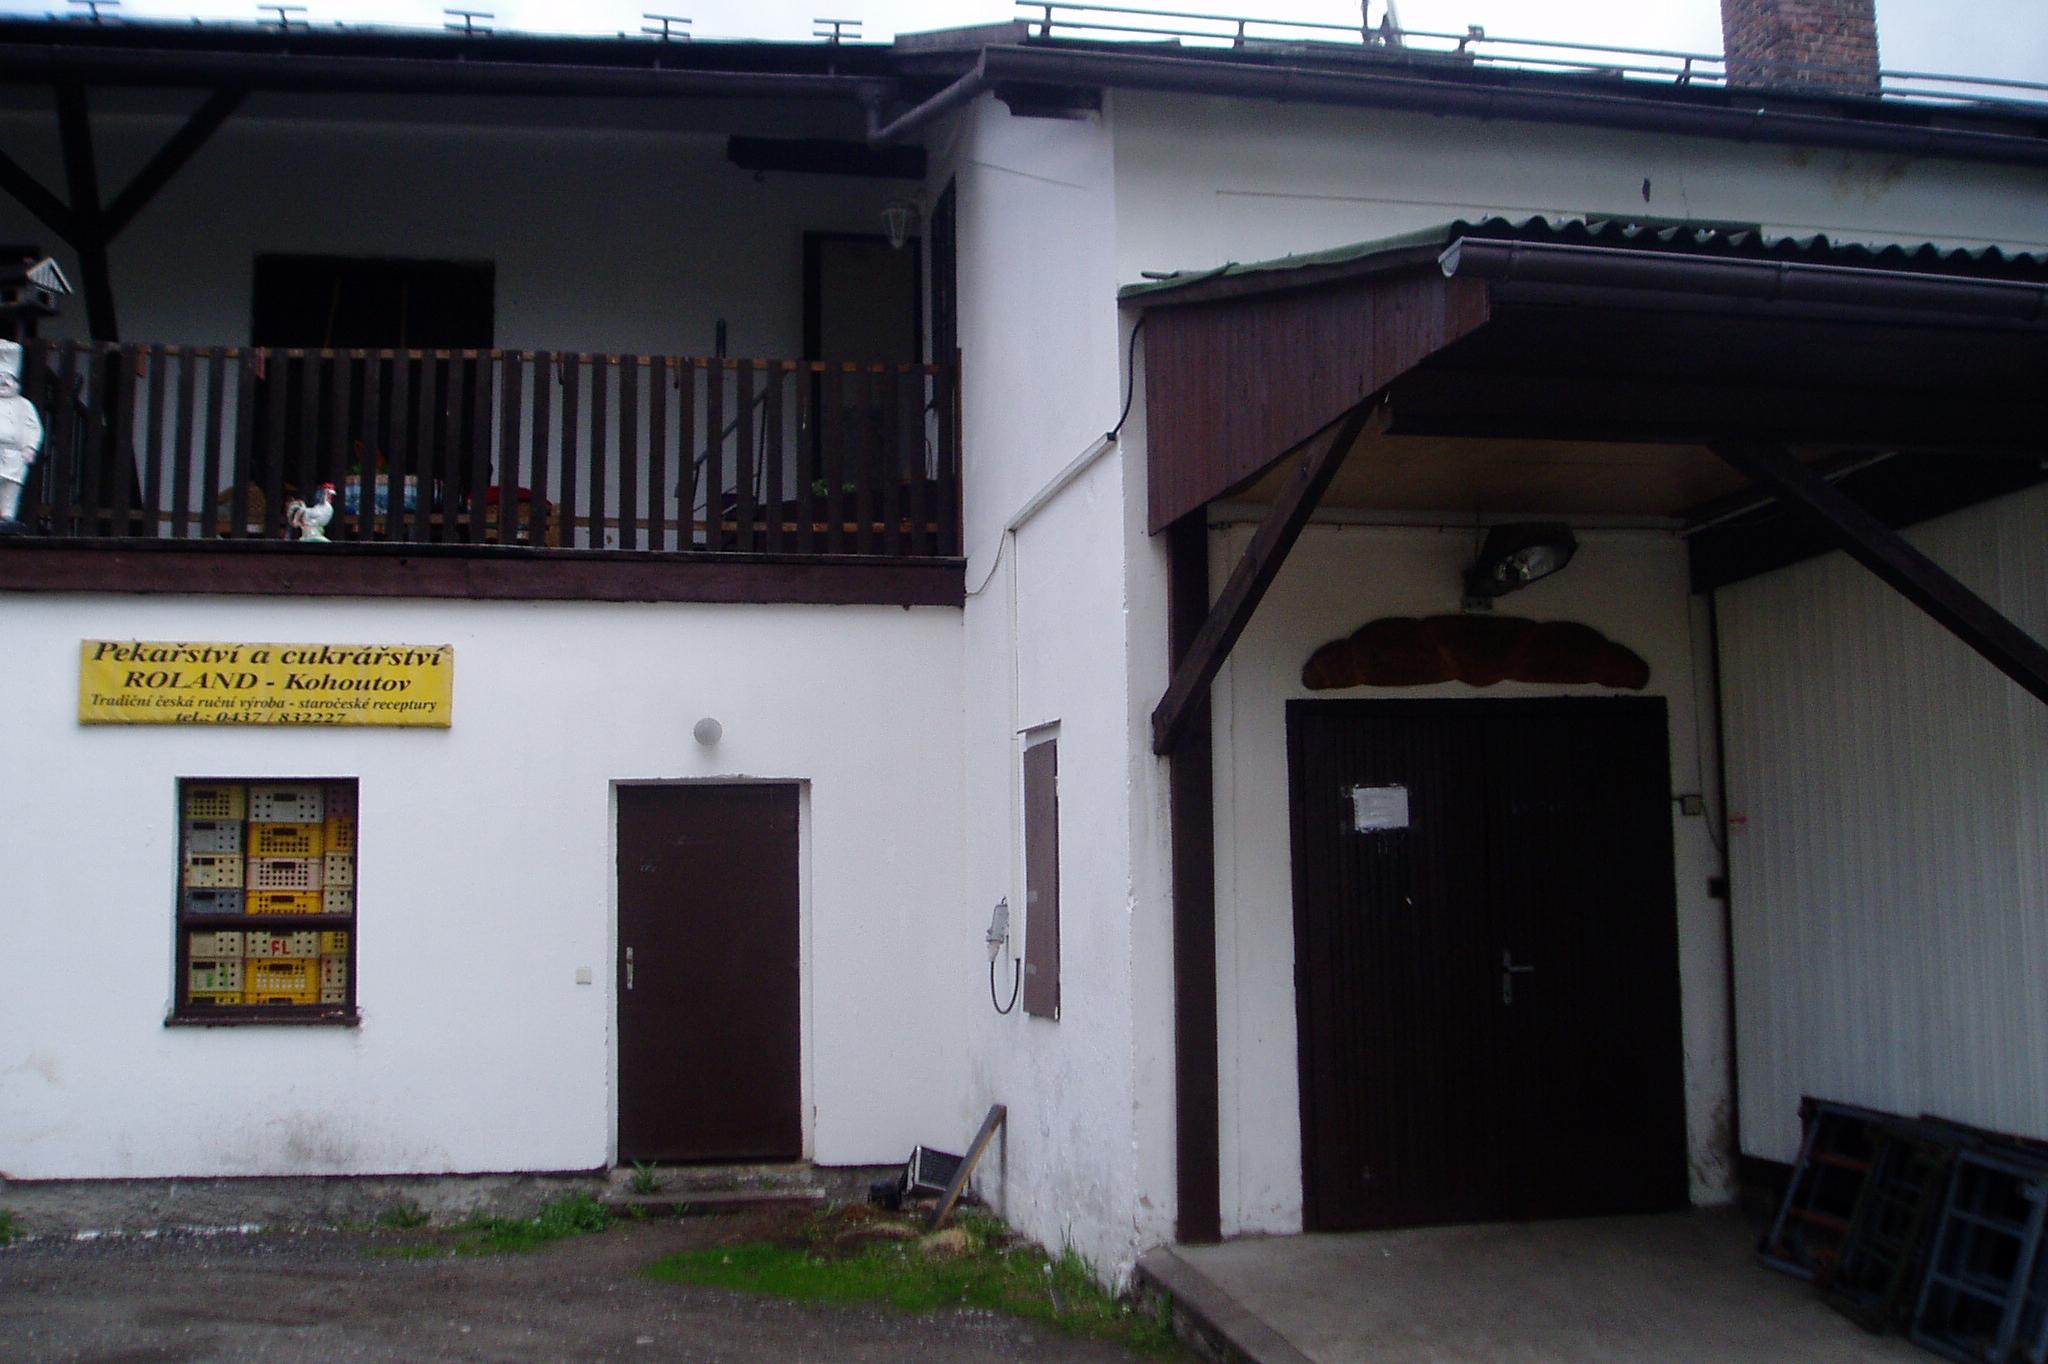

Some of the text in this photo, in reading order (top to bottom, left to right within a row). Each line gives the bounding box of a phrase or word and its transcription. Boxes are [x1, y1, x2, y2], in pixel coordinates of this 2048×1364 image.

[92, 642, 446, 667] Pekařství a cukrářství
[123, 671, 258, 689] ROLAND
[285, 673, 412, 692] Kohoutov
[91, 693, 153, 707] Tradiční
[155, 695, 195, 708] česká
[198, 695, 236, 708] ruční
[239, 696, 285, 710] výroba
[299, 697, 371, 710] staročeské
[373, 699, 437, 713] receptury
[217, 711, 262, 723] 0437
[278, 712, 347, 723] 832227
